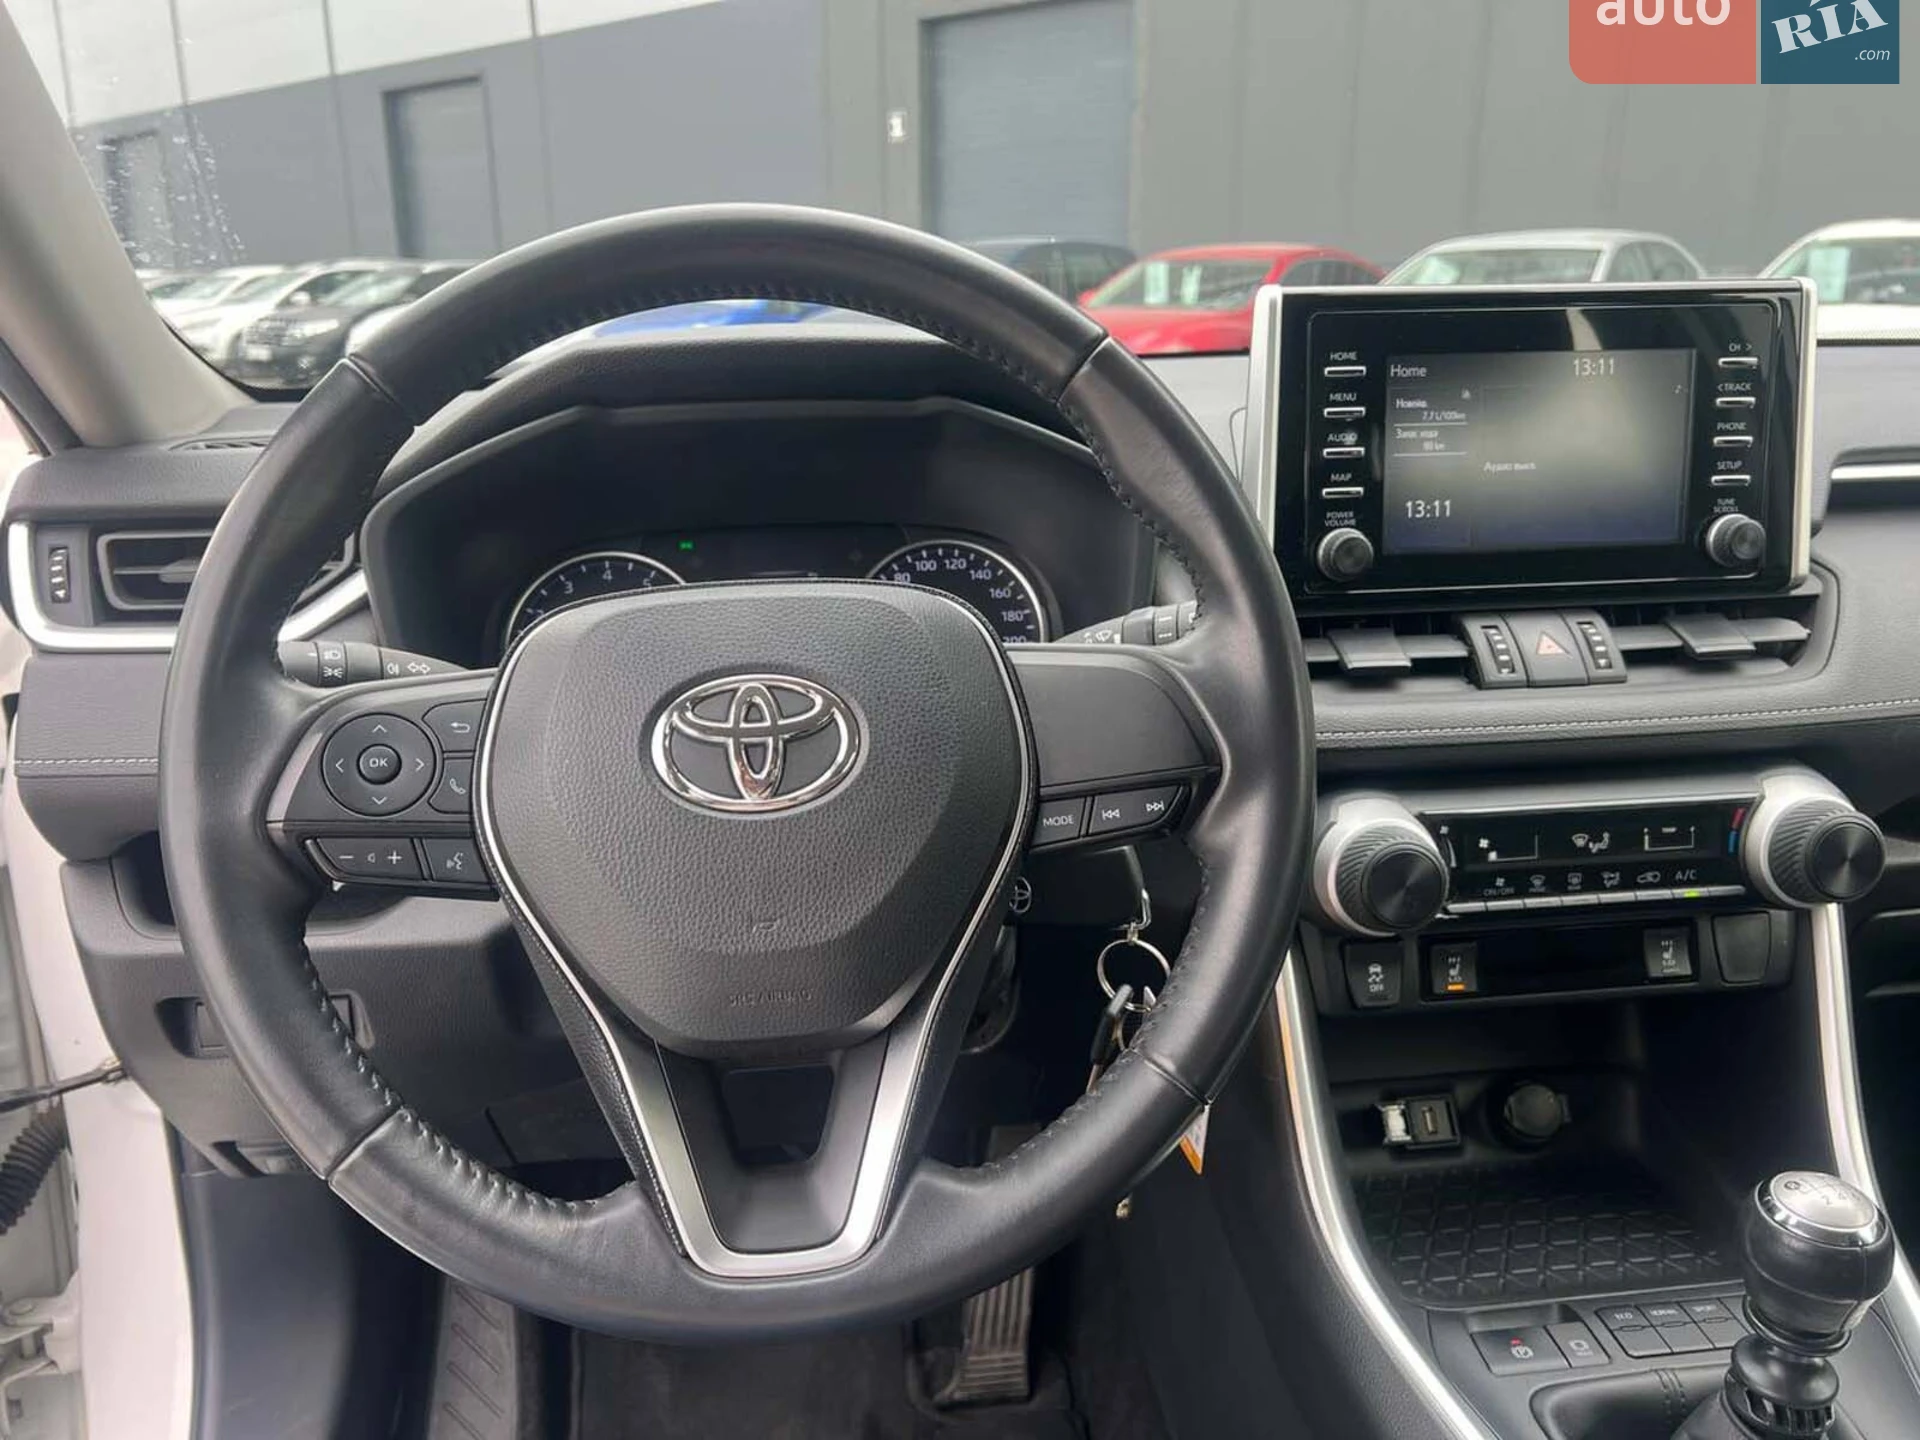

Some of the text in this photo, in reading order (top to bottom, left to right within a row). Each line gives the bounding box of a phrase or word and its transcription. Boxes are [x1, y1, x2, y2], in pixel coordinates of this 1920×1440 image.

[1330, 352, 1357, 361] HOME
[1390, 364, 1428, 378] Home
[1573, 357, 1615, 376] 13:11
[1329, 393, 1357, 402] MENU
[1717, 422, 1747, 431] PHONE
[1327, 433, 1358, 443] AUDIO
[1716, 461, 1742, 470] SETUP
[1331, 473, 1352, 482] MAP
[1405, 500, 1452, 518] 13:11
[1326, 511, 1354, 519] POWER
[915, 560, 937, 571] 100
[945, 558, 967, 569] 120
[602, 569, 613, 581] 4
[893, 572, 911, 583] 80
[970, 569, 992, 580] 140
[565, 582, 574, 594] 3
[989, 588, 1012, 599] 160
[1002, 610, 1024, 622] 180
[369, 758, 389, 768] OK
[1042, 813, 1075, 828] MODE
[1675, 869, 1698, 882] A/C
